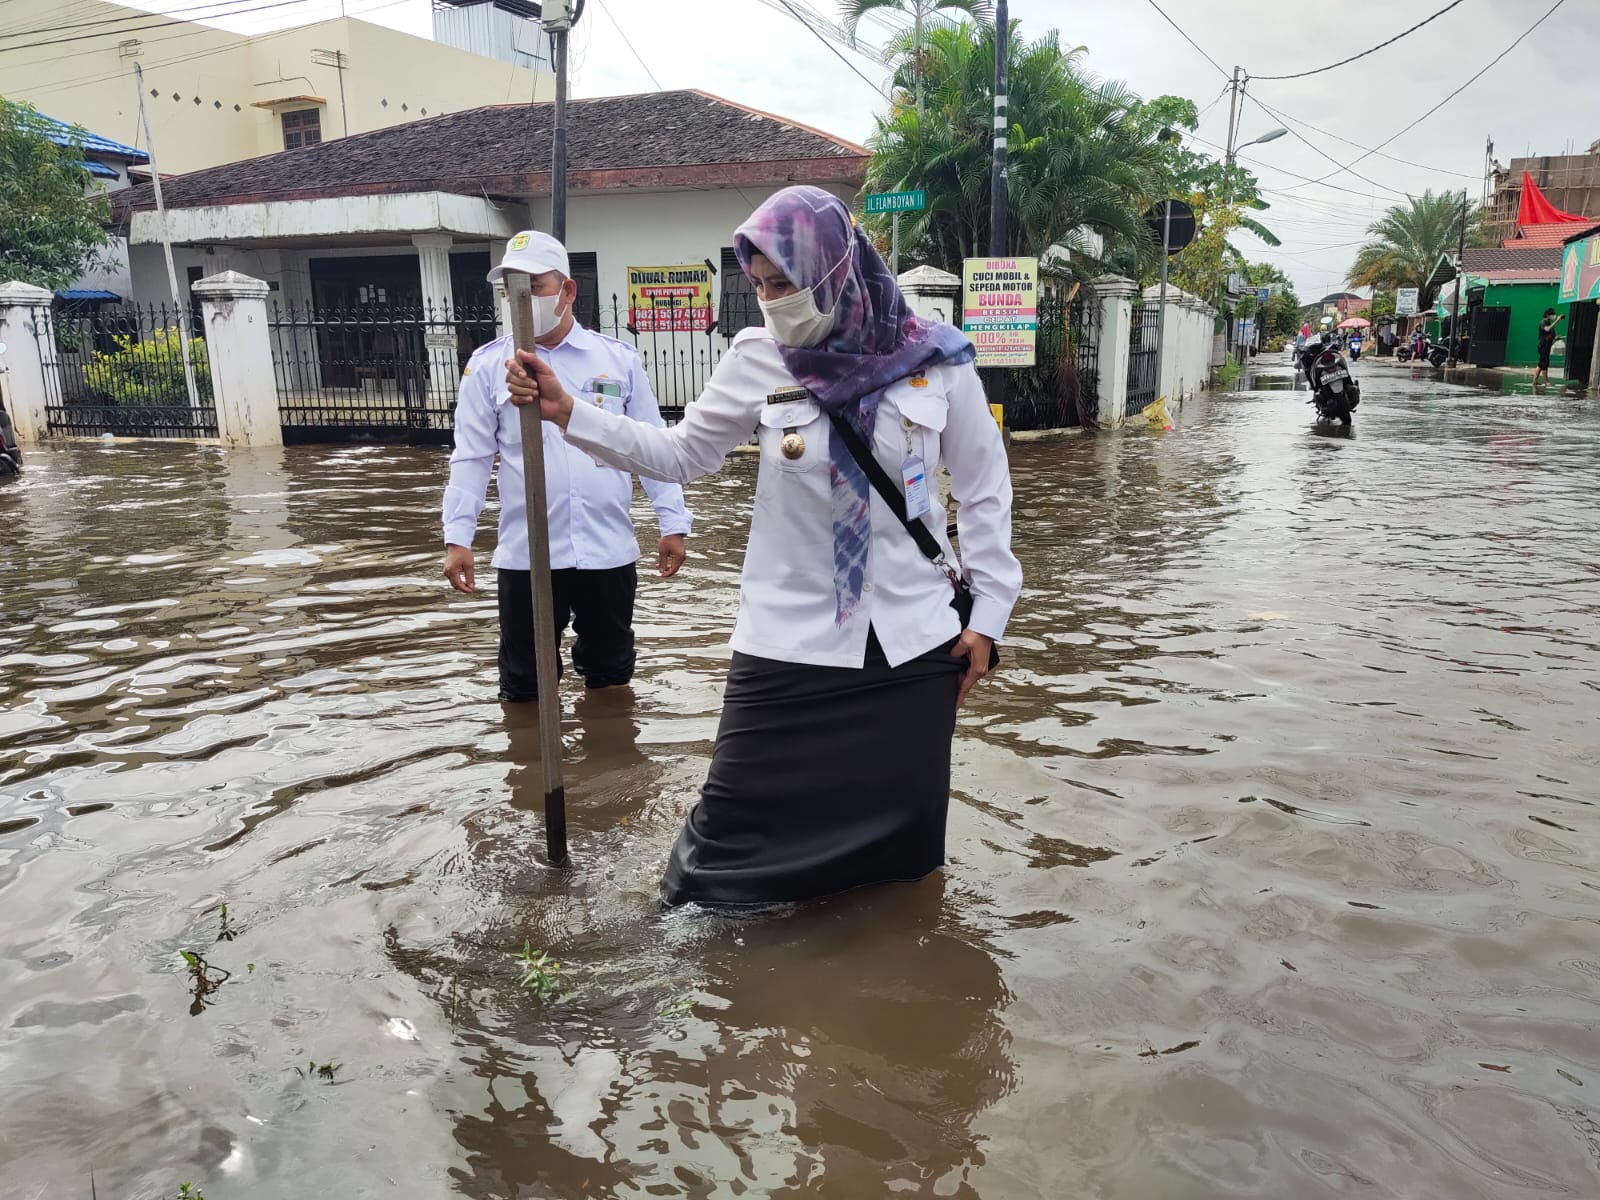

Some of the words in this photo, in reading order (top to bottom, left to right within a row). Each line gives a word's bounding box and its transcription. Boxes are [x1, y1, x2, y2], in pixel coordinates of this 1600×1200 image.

[986, 261, 1017, 270] DIBUKA
[630, 271, 666, 284] DIJUAL
[668, 270, 708, 283] RUMAH
[972, 272, 993, 281] CUCI
[995, 271, 1022, 281] MOBIL
[1024, 272, 1030, 280] &
[969, 282, 1001, 292] SEPEDA
[1002, 282, 1033, 291] MOTOR
[979, 293, 1022, 307] BUNDA
[970, 323, 1030, 331] MENGKILAP
[974, 332, 1006, 344] 100%
